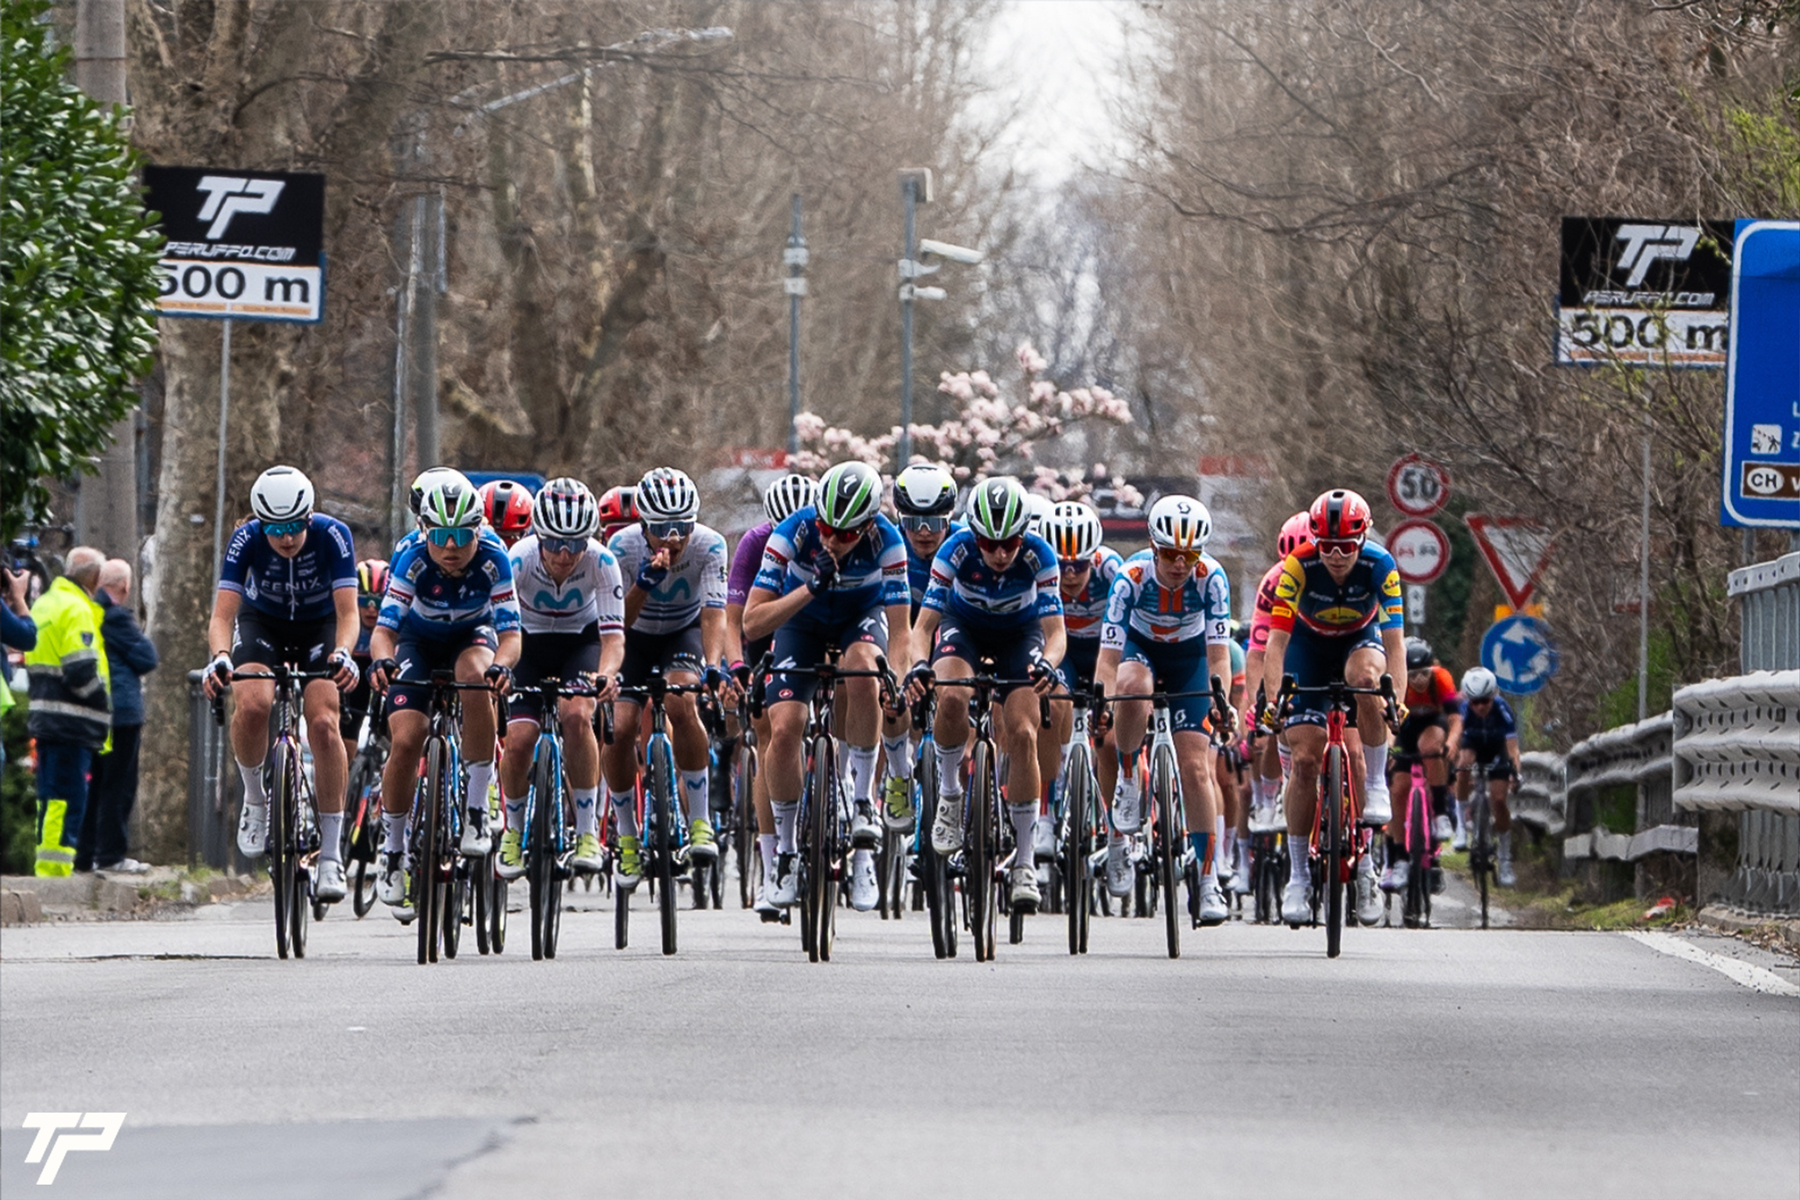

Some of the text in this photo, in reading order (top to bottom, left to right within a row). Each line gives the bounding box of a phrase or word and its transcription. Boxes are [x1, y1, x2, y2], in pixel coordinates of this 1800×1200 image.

[196, 175, 286, 240] TP
[161, 241, 296, 261] PERUFFO.COM
[1616, 224, 1701, 287] TP
[264, 276, 309, 303] m
[1572, 313, 1729, 350] 500 m
[1401, 468, 1439, 499] 50
[1751, 473, 1777, 488] CH
[226, 528, 251, 564] FENIX
[261, 576, 324, 592] FENIX
